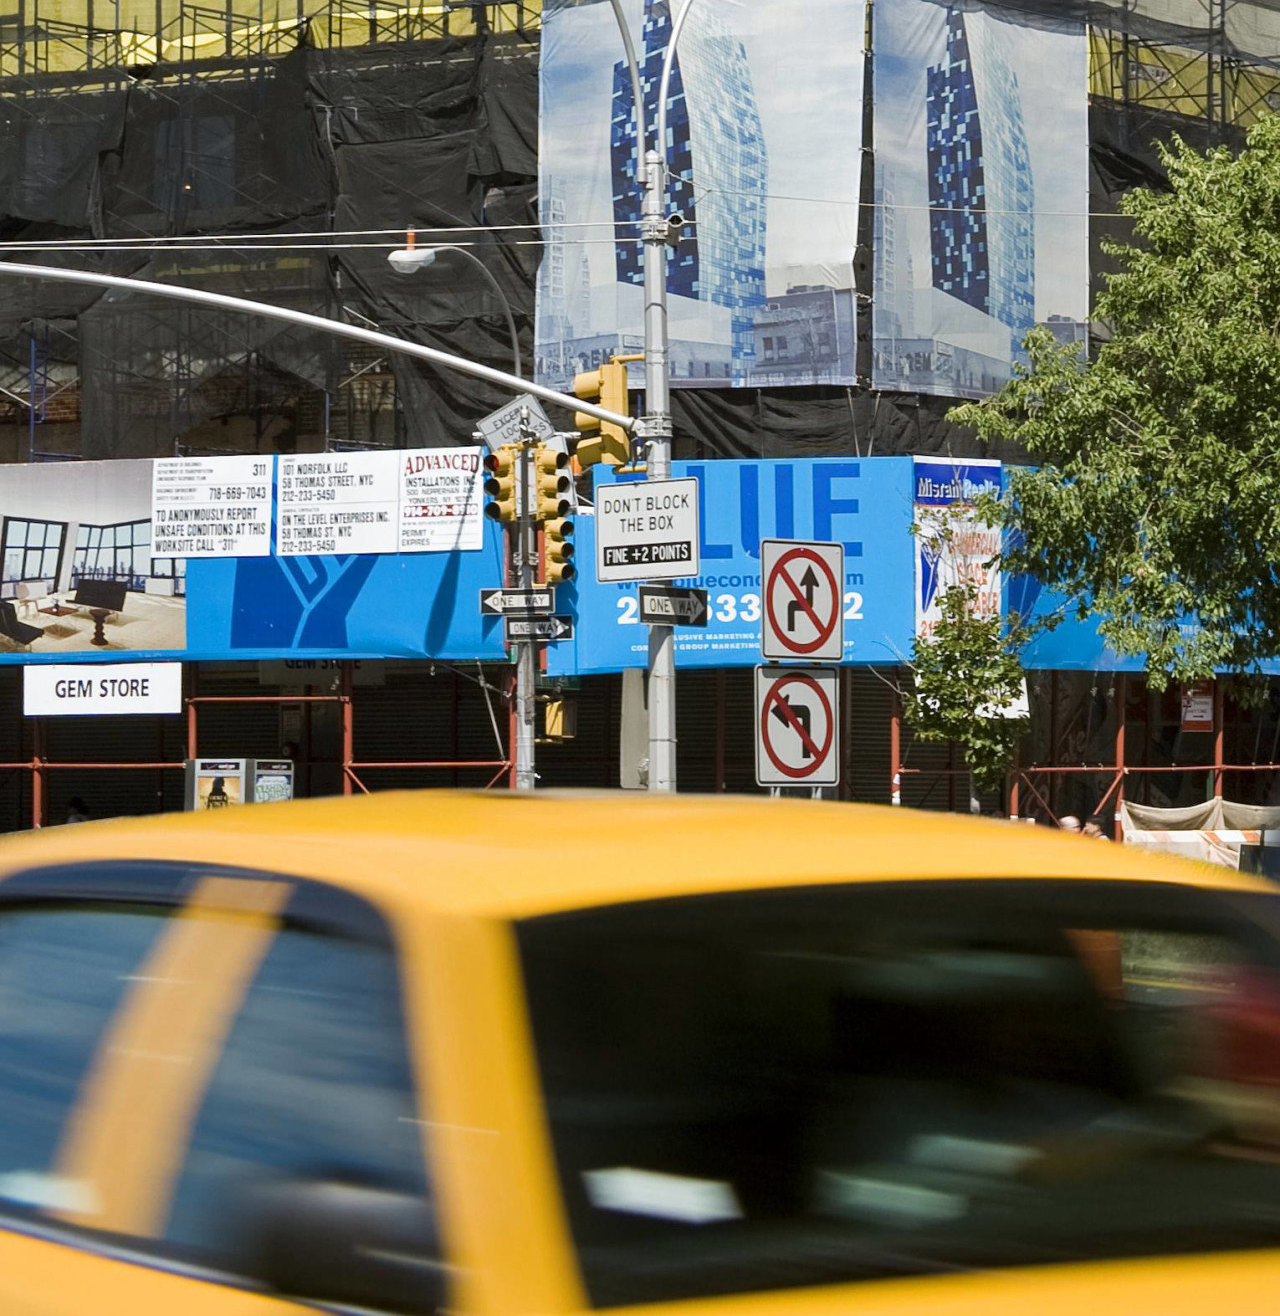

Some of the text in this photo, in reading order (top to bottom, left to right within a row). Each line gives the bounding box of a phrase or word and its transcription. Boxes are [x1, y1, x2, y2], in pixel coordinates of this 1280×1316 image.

[493, 408, 521, 430] EXCEP
[501, 423, 521, 440] LOC
[253, 464, 266, 476] 311
[283, 462, 348, 475] 101 NORFOLK LLC
[404, 454, 480, 477] ADVANCED
[282, 477, 292, 489] 58
[295, 476, 325, 488] THOMAS
[359, 474, 374, 486] NYC
[406, 476, 459, 487] INSTALLATIONS
[209, 487, 266, 500] 718-669-7043
[282, 489, 335, 502] 212-233-5450
[604, 494, 689, 514] DON'T BLOCK
[616, 463, 863, 559] LUE
[156, 508, 257, 522] TO ANONYMOUSLY REPORT
[282, 515, 291, 526] ON
[293, 514, 306, 525] THE
[308, 513, 327, 525] LEVEL
[330, 512, 374, 524] ENTERPRISES
[155, 523, 266, 537] UNSAFE CONDITIONS AT THIS
[620, 515, 674, 533] THE BOX
[282, 528, 291, 539] 58
[293, 527, 322, 539] THOMAS
[338, 526, 352, 537] NYC
[402, 529, 427, 537] PERMIT
[155, 539, 194, 552] WORKSITE
[196, 539, 215, 551] CALL
[282, 540, 335, 552] 212-233-5450
[606, 544, 688, 564] FINE +2 POINTS
[492, 596, 545, 606] ONE WAY
[650, 598, 670, 613] ONE
[677, 599, 698, 614] WAY
[514, 623, 559, 634] ONE WAY
[55, 678, 149, 698] GEM STORE
